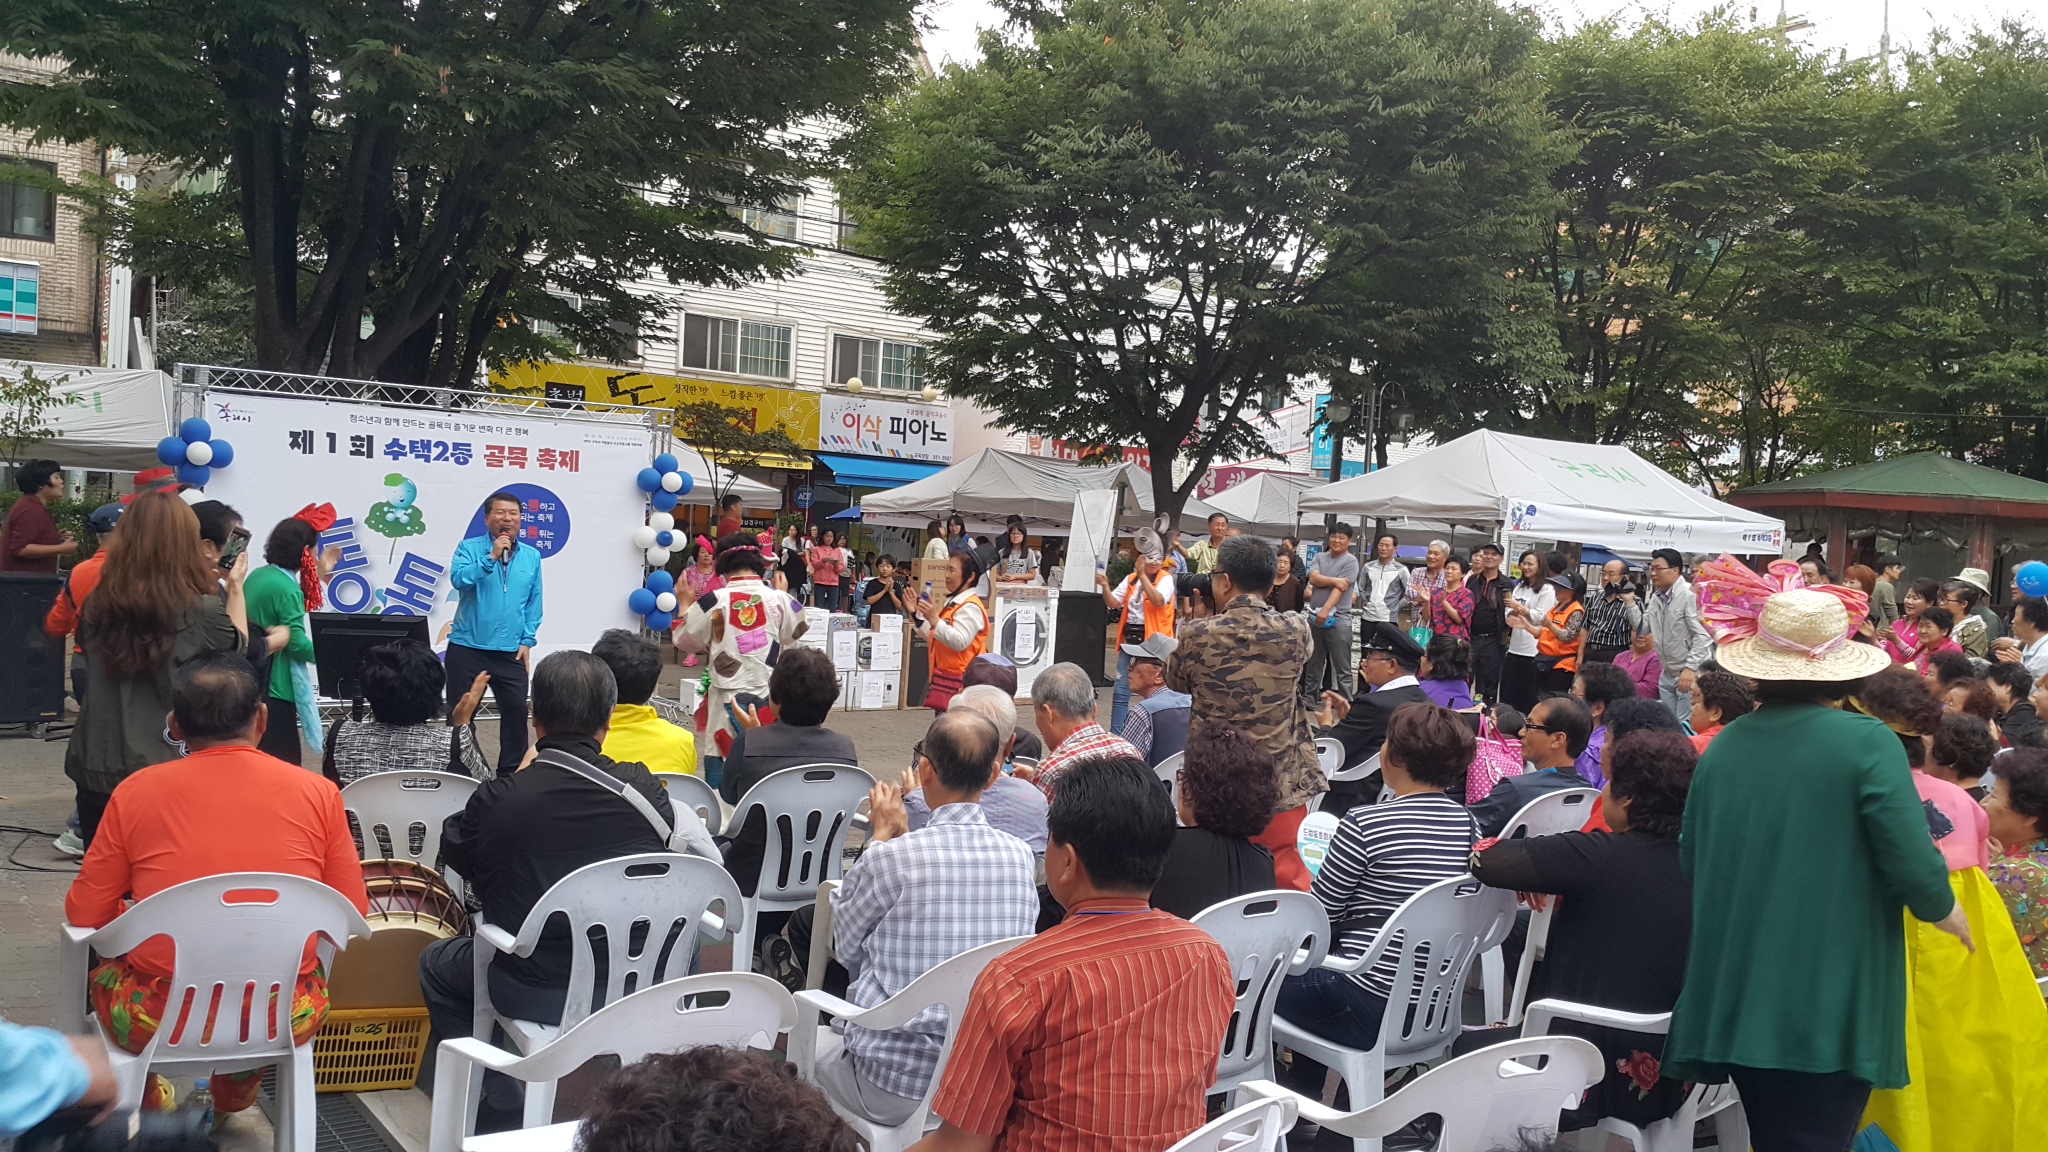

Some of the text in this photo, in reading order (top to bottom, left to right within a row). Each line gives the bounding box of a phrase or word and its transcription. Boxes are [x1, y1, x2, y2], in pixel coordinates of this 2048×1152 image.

[673, 384, 697, 395] 정직한
[384, 417, 400, 427] 함께
[403, 419, 425, 429] 만드는
[428, 420, 450, 431] 골목의
[453, 421, 476, 433] 즐거운
[478, 424, 494, 434] 변화
[495, 426, 503, 435] 더
[505, 427, 513, 436] 큰
[514, 427, 529, 437] 행복
[842, 412, 948, 447] 이삭 피아노
[289, 429, 580, 472] 제 1 회 수택2동 골목 축제
[797, 492, 812, 501] ADT
[537, 513, 553, 523] 축제
[535, 540, 552, 550] 축제
[354, 1023, 386, 1036] GS25
